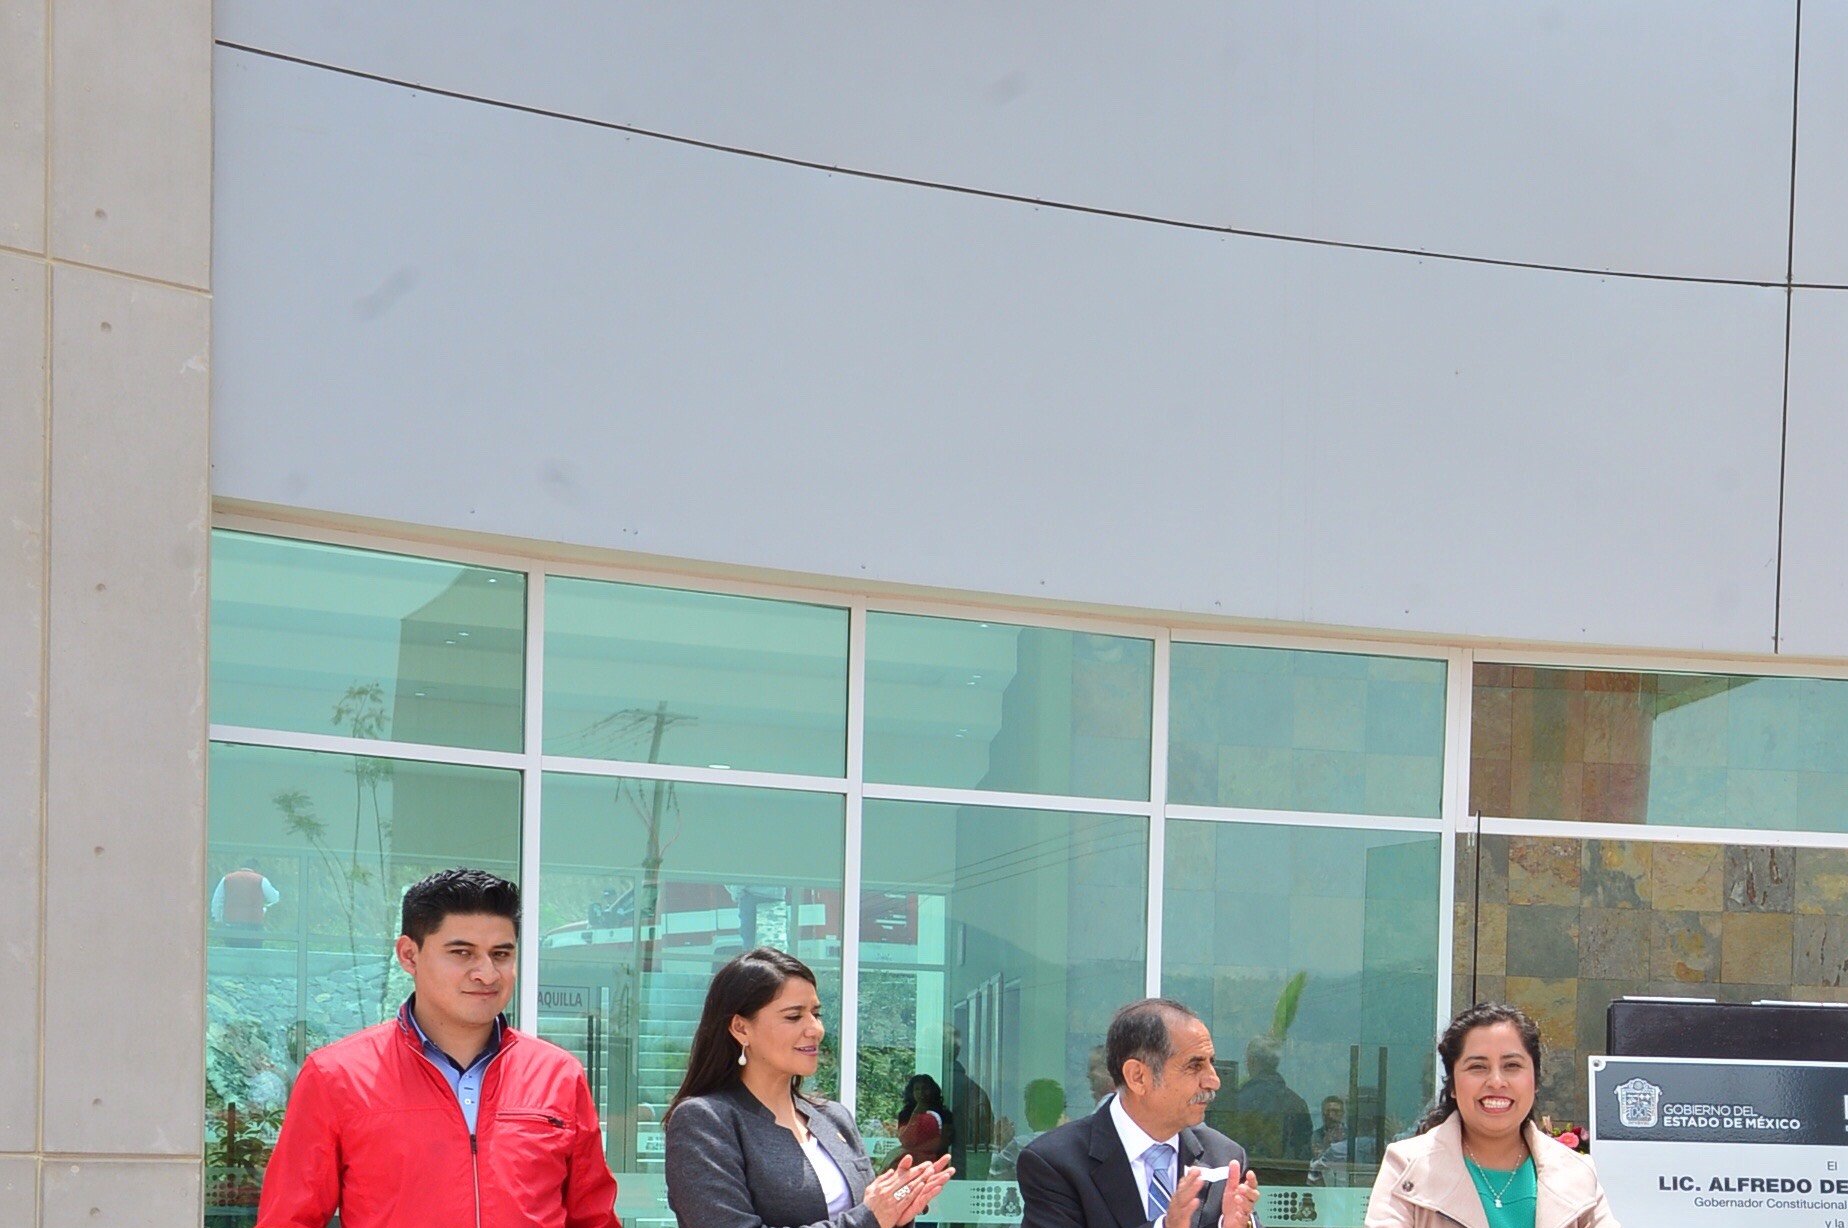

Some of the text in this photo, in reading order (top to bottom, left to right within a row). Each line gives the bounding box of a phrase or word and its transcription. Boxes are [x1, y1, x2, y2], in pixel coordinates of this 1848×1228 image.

[537, 991, 583, 1008] AQUILLA
[1663, 1104, 1757, 1117] GOBIERNO DEL
[1664, 1115, 1800, 1130] ESTADO DE MÉXICO
[1827, 1161, 1837, 1171] El
[1659, 1176, 1701, 1191] LIC.
[1709, 1177, 1812, 1193] ALFREDO
[1694, 1197, 1762, 1208] Gobernador
[1767, 1198, 1847, 1210] Constitucional
[1835, 1219, 1845, 1228] la
